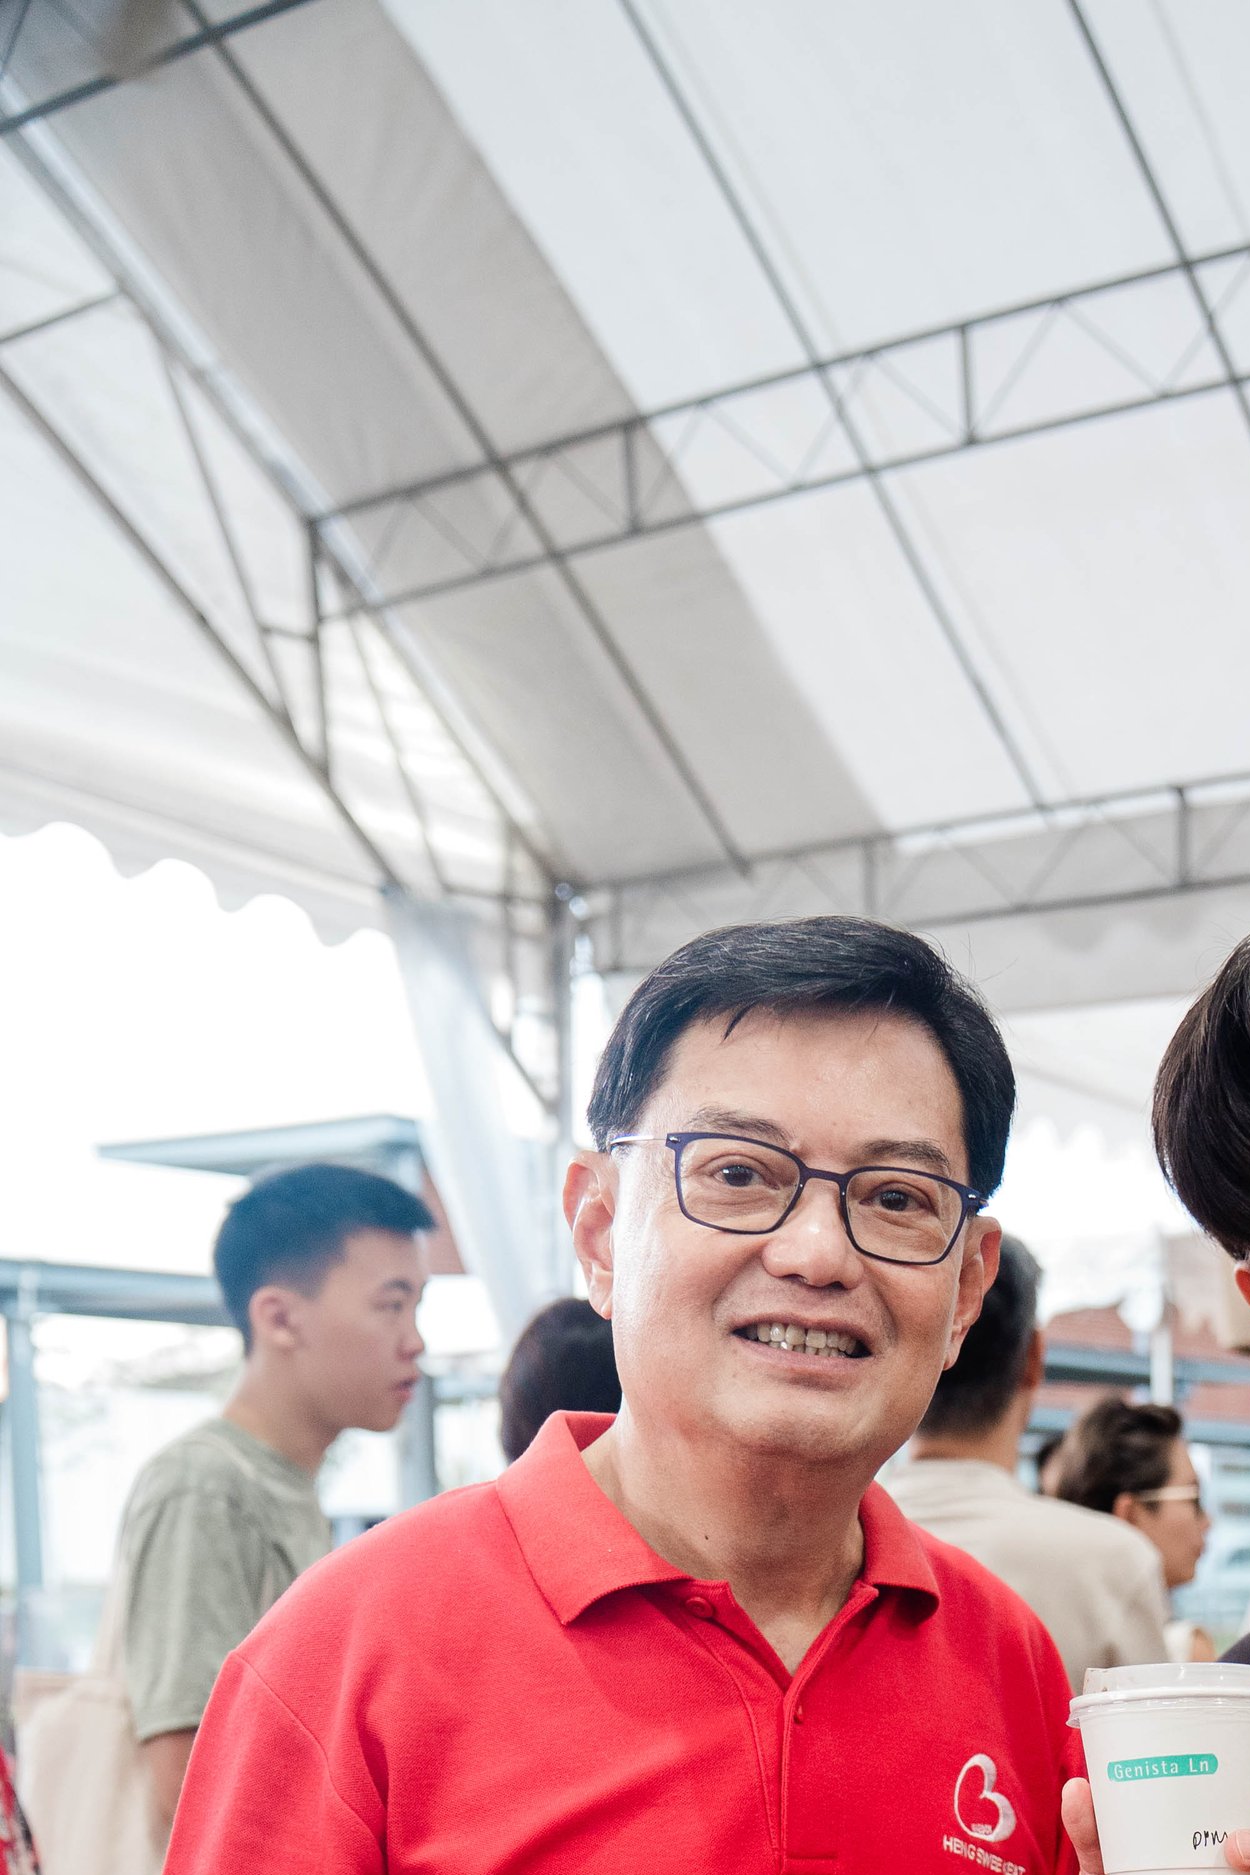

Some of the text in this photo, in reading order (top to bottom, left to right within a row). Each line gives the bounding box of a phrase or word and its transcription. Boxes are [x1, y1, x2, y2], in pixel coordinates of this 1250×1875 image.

[1114, 1757, 1209, 1779] Genista Ln
[943, 1834, 976, 1860] HENG
[976, 1847, 1003, 1873] SWEE
